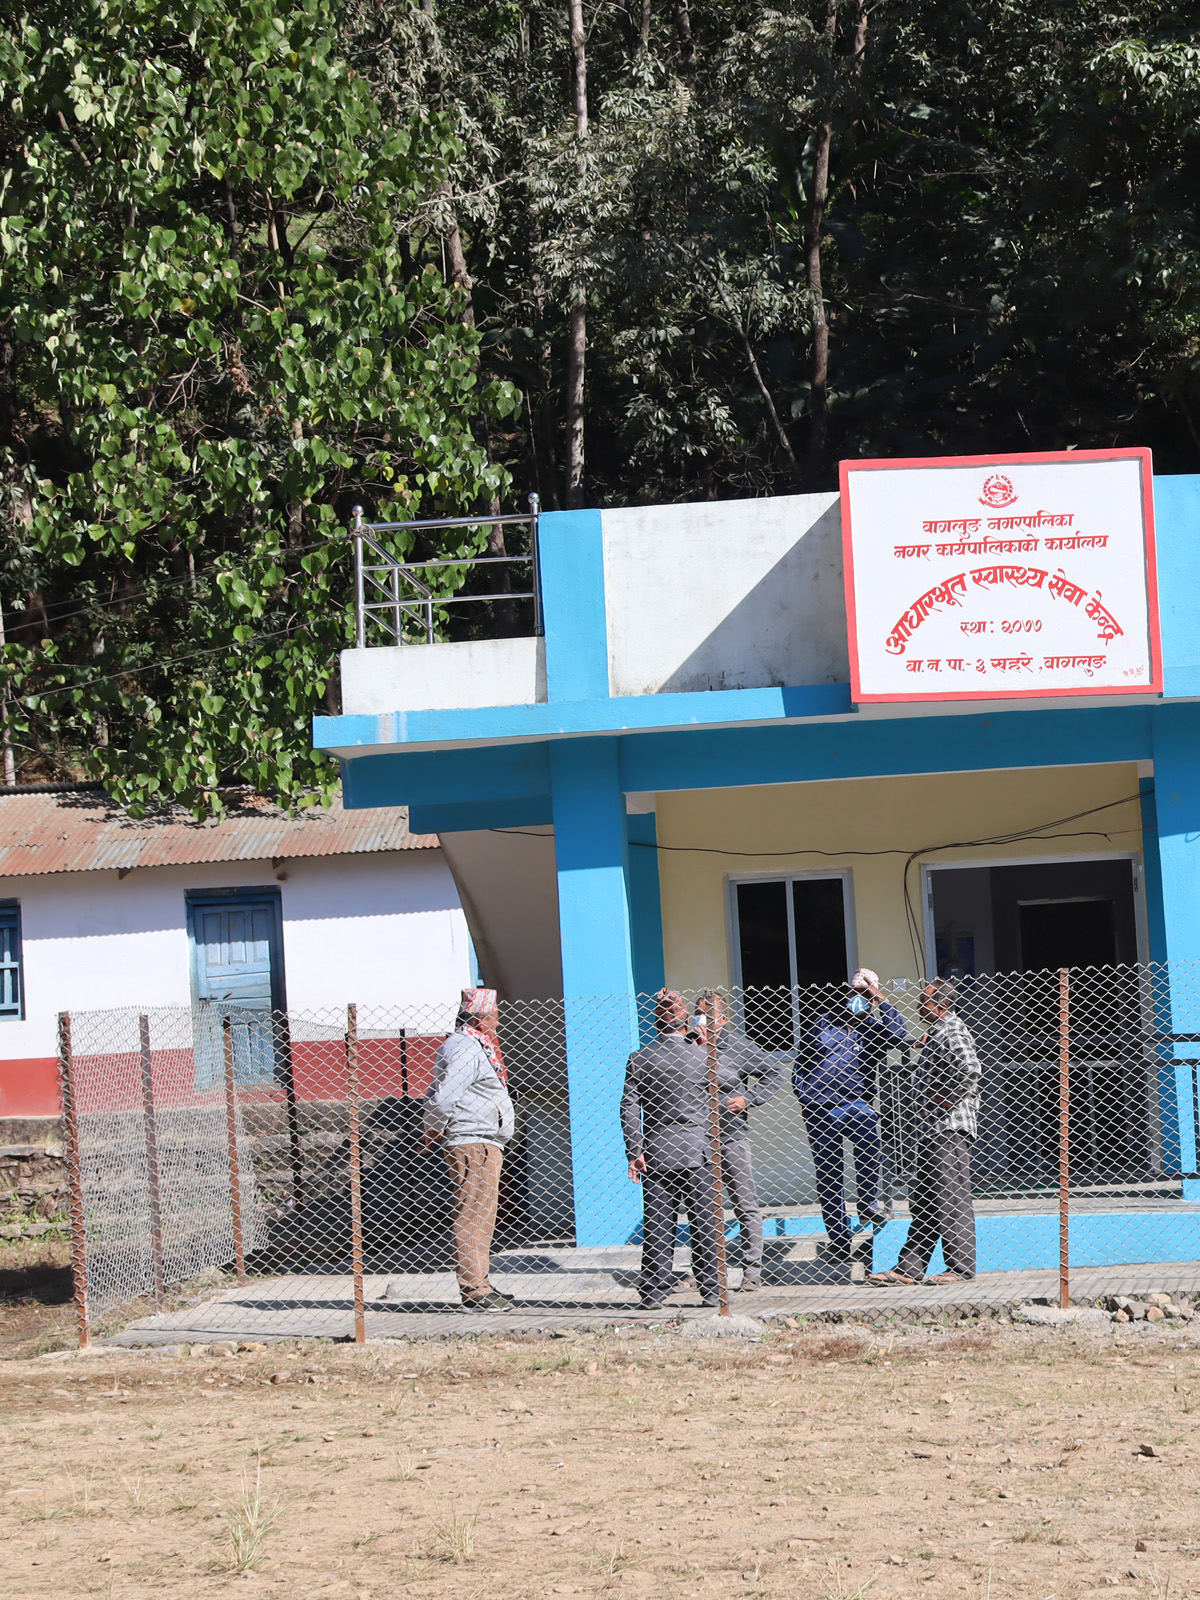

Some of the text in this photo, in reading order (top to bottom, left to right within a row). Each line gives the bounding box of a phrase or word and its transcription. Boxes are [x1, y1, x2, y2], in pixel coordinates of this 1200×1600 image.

[987, 510, 1074, 532] नगरपालिका
[894, 531, 1109, 561] नगर कार्यपालिकाको कार्यालय
[885, 565, 1124, 655] आधारभूत स्वास्थ्य सेवा केन्द्र
[1001, 619, 1042, 635] २०७७
